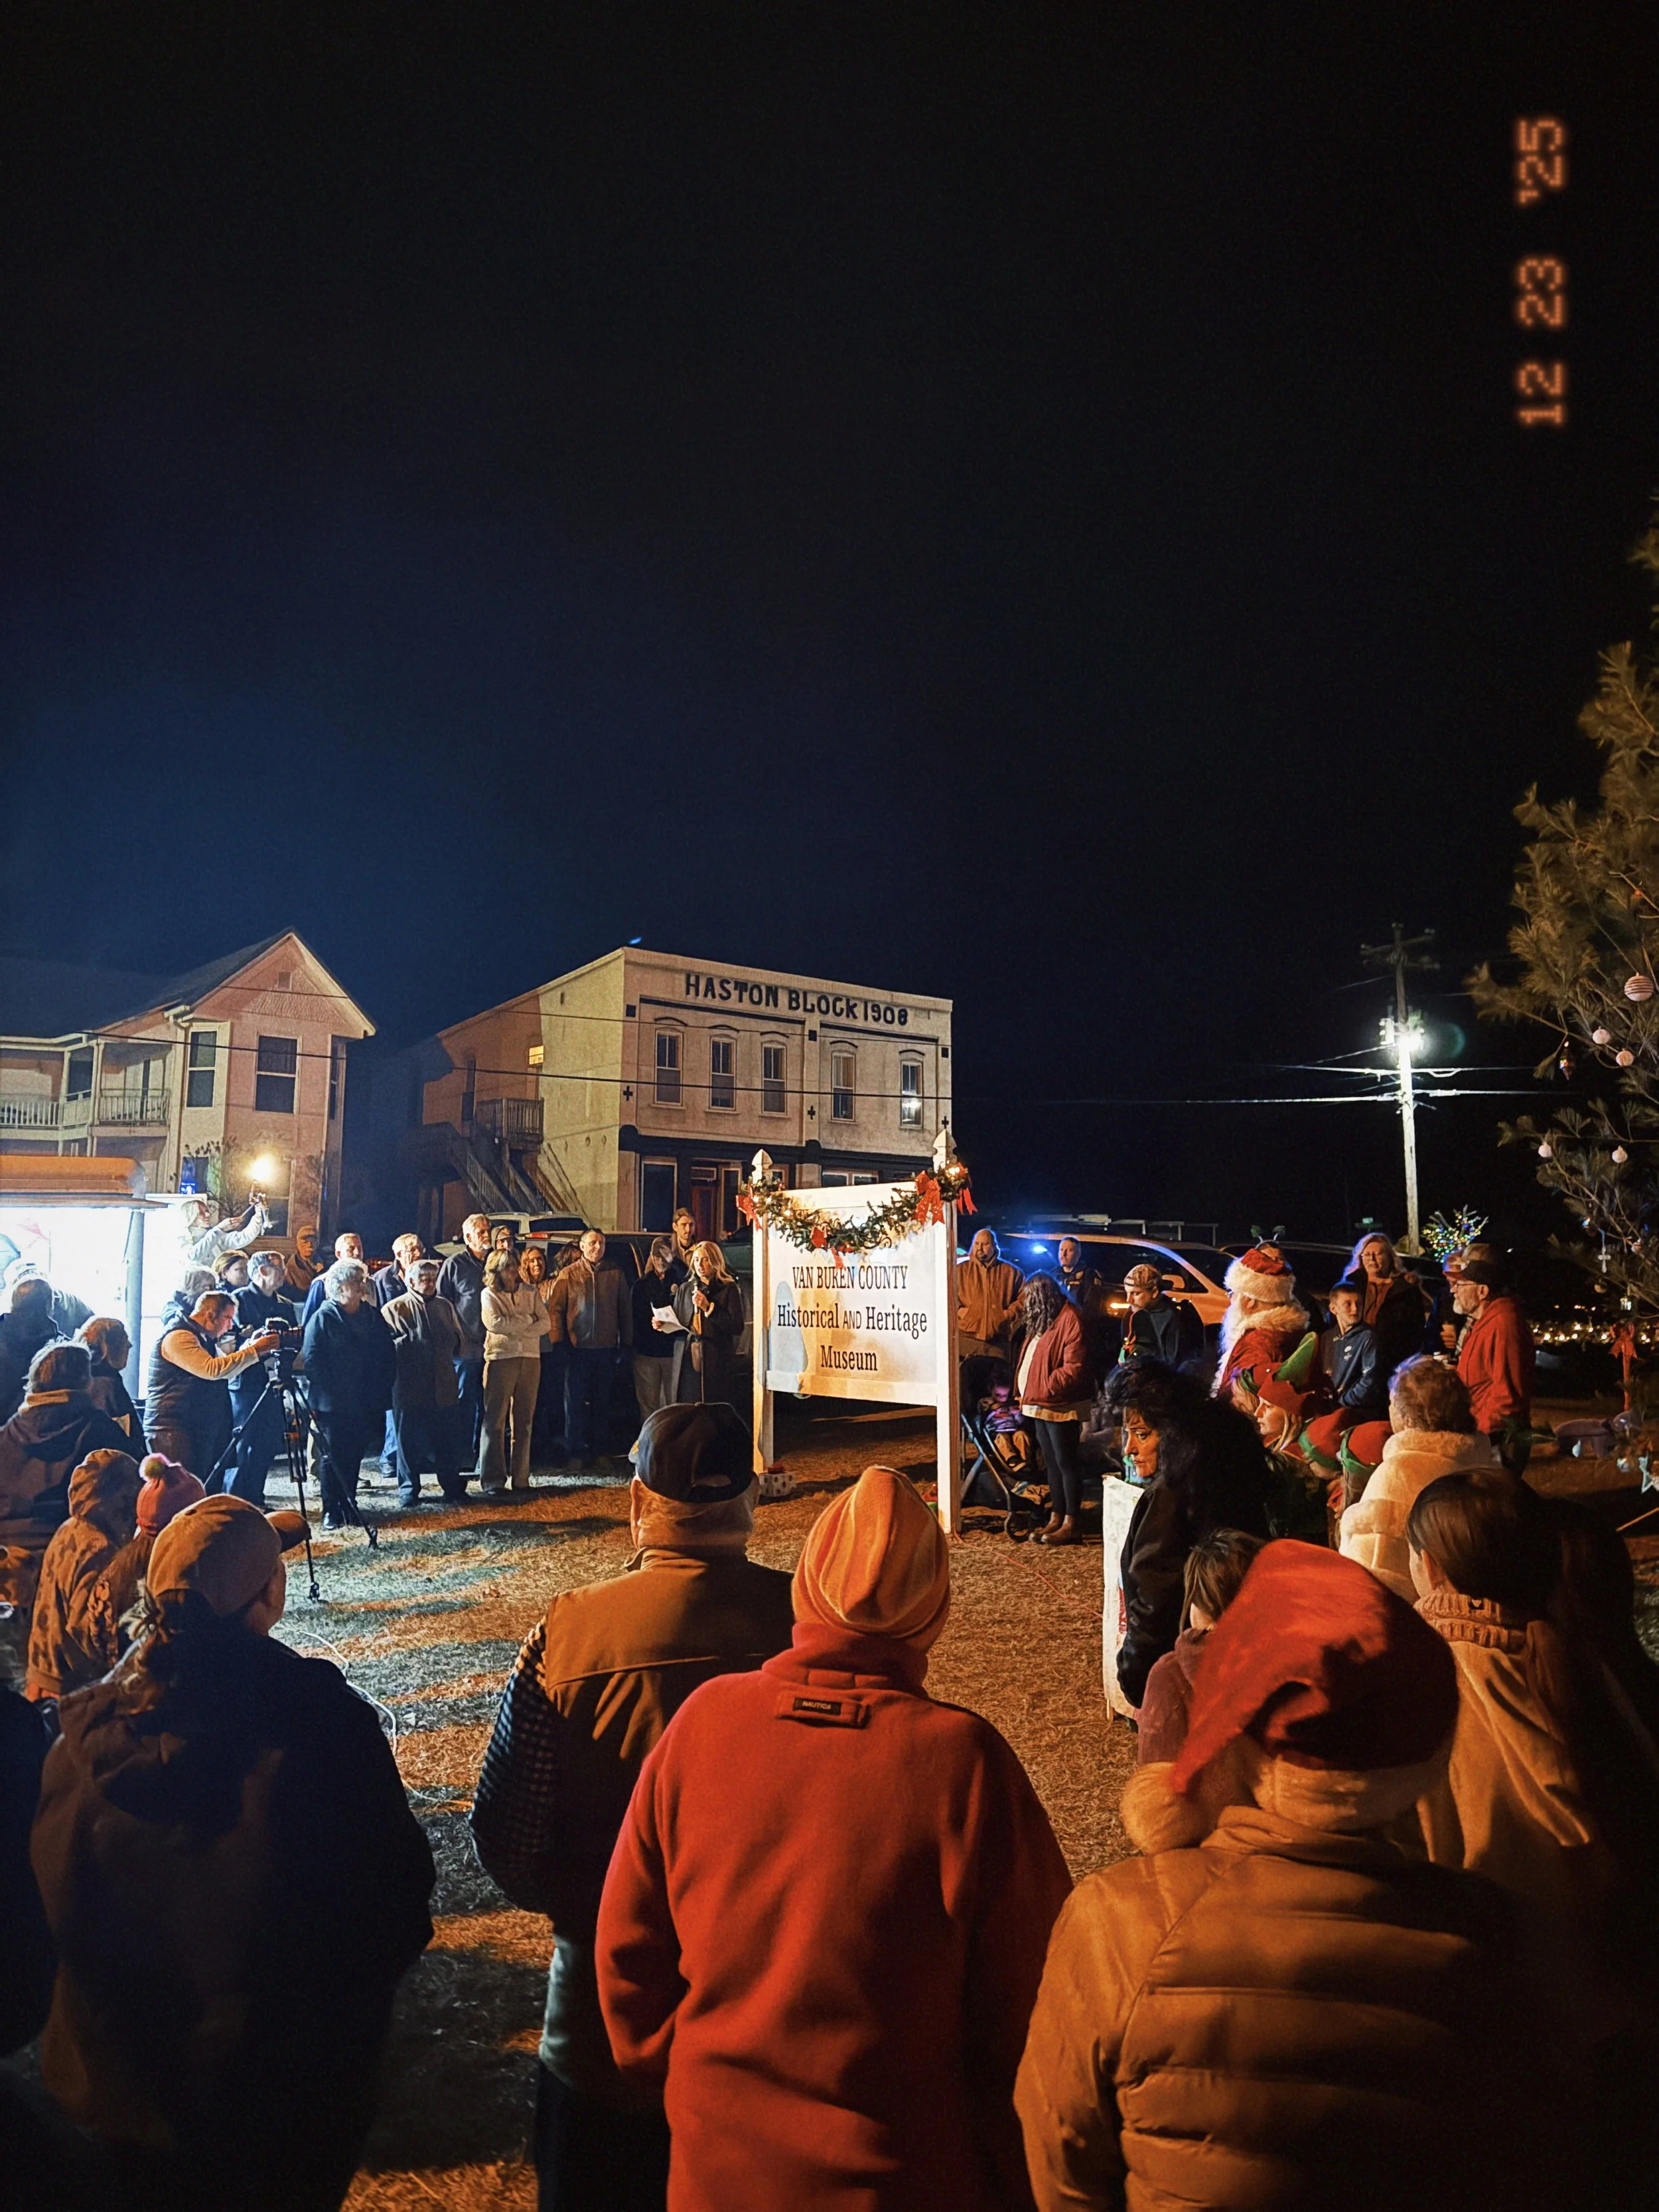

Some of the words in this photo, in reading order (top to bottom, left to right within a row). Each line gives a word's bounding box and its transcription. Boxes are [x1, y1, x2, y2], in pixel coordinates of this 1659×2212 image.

[685, 972, 779, 1009] HASTON
[788, 989, 857, 1020] BLOCK
[863, 999, 908, 1027] 1908
[792, 1266, 814, 1289] VAN
[816, 1266, 855, 1290] BUREN
[858, 1265, 908, 1290] COUNTY
[777, 1302, 839, 1329] Historical
[843, 1311, 862, 1329] AND
[865, 1303, 928, 1340] Heritage
[820, 1345, 879, 1372] Museum
[802, 1700, 831, 1710] NAUTICA
